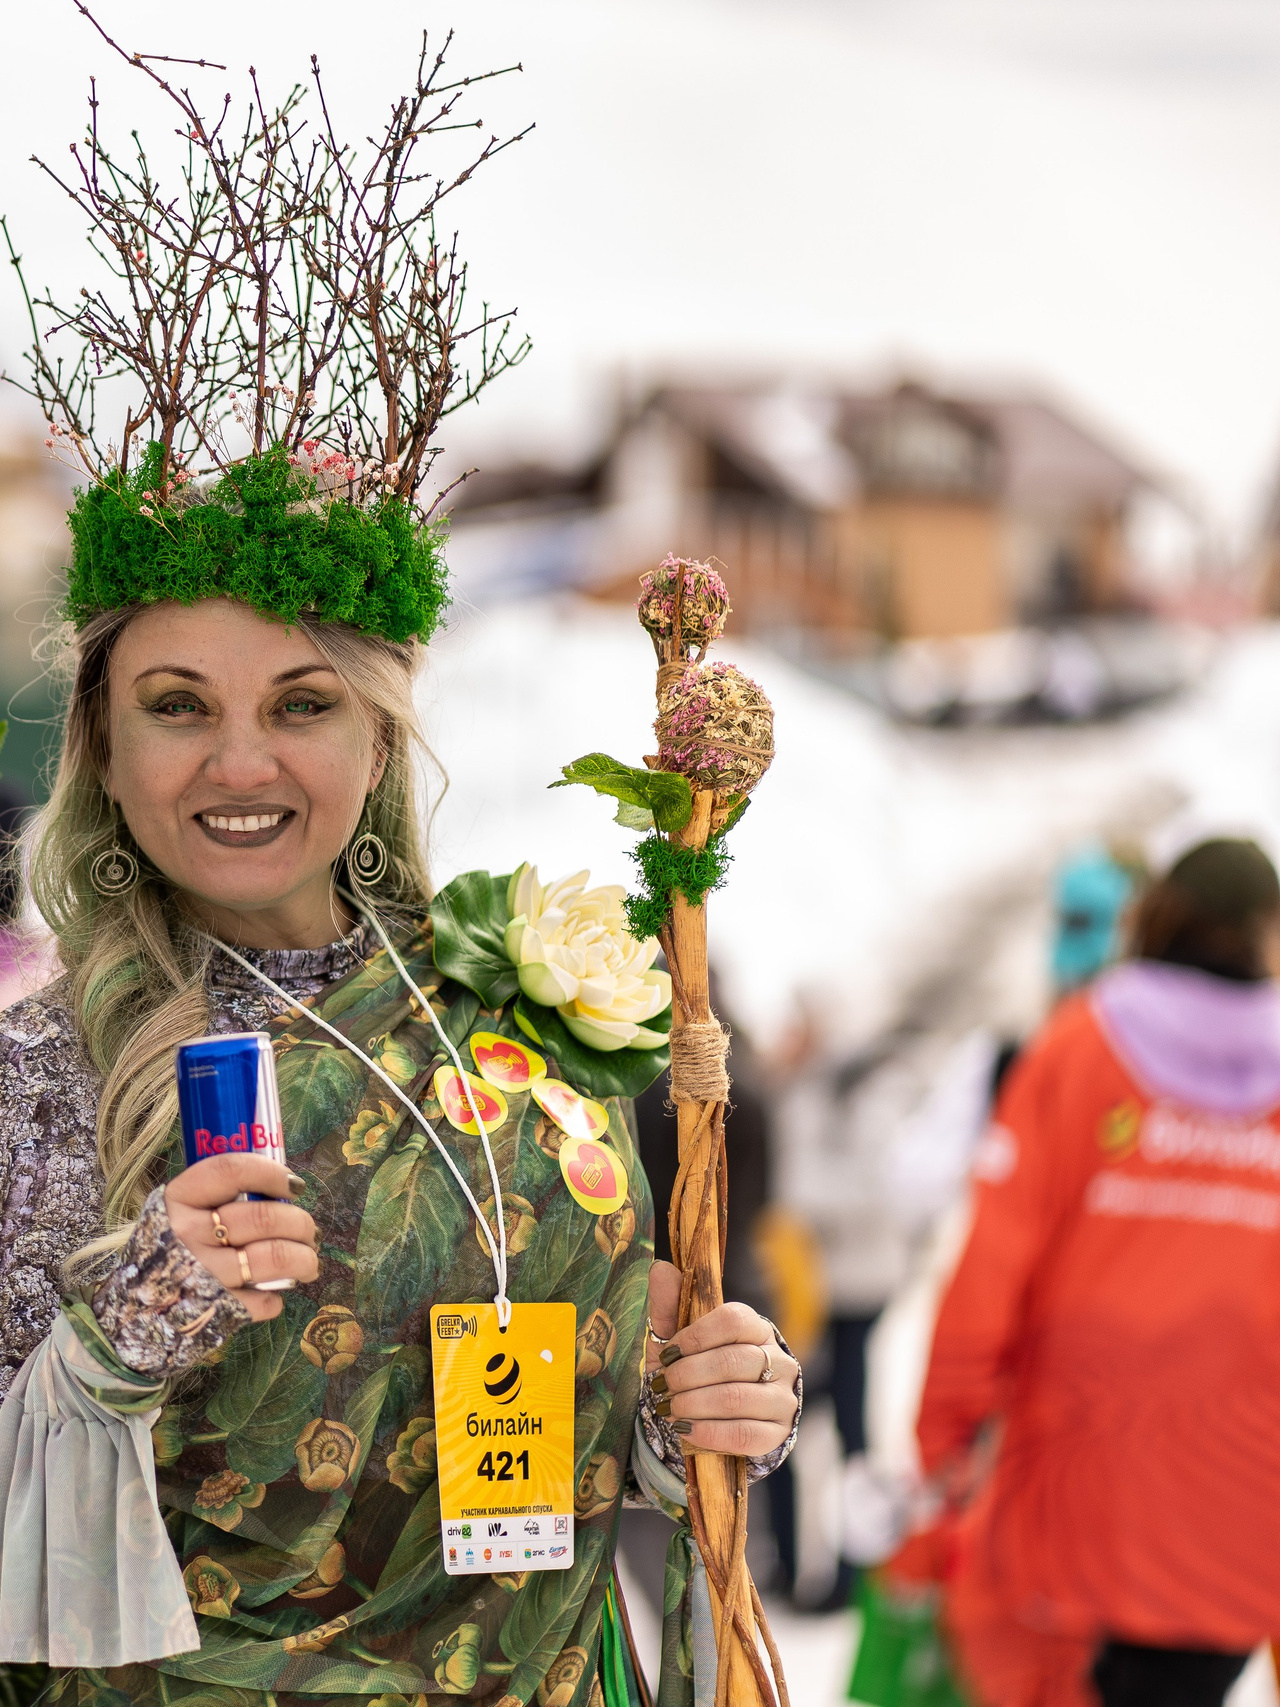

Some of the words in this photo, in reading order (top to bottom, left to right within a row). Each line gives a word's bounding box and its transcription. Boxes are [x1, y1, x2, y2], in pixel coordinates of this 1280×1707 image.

[195, 1122, 249, 1156] Red
[441, 1327, 454, 1335] FEST
[466, 1411, 543, 1437] билайн
[477, 1450, 531, 1482] 421
[461, 1508, 487, 1518] УЧАСТНИК
[488, 1506, 531, 1516] КАРНАВАЛЬНОГО
[532, 1505, 553, 1514] СПУСКА
